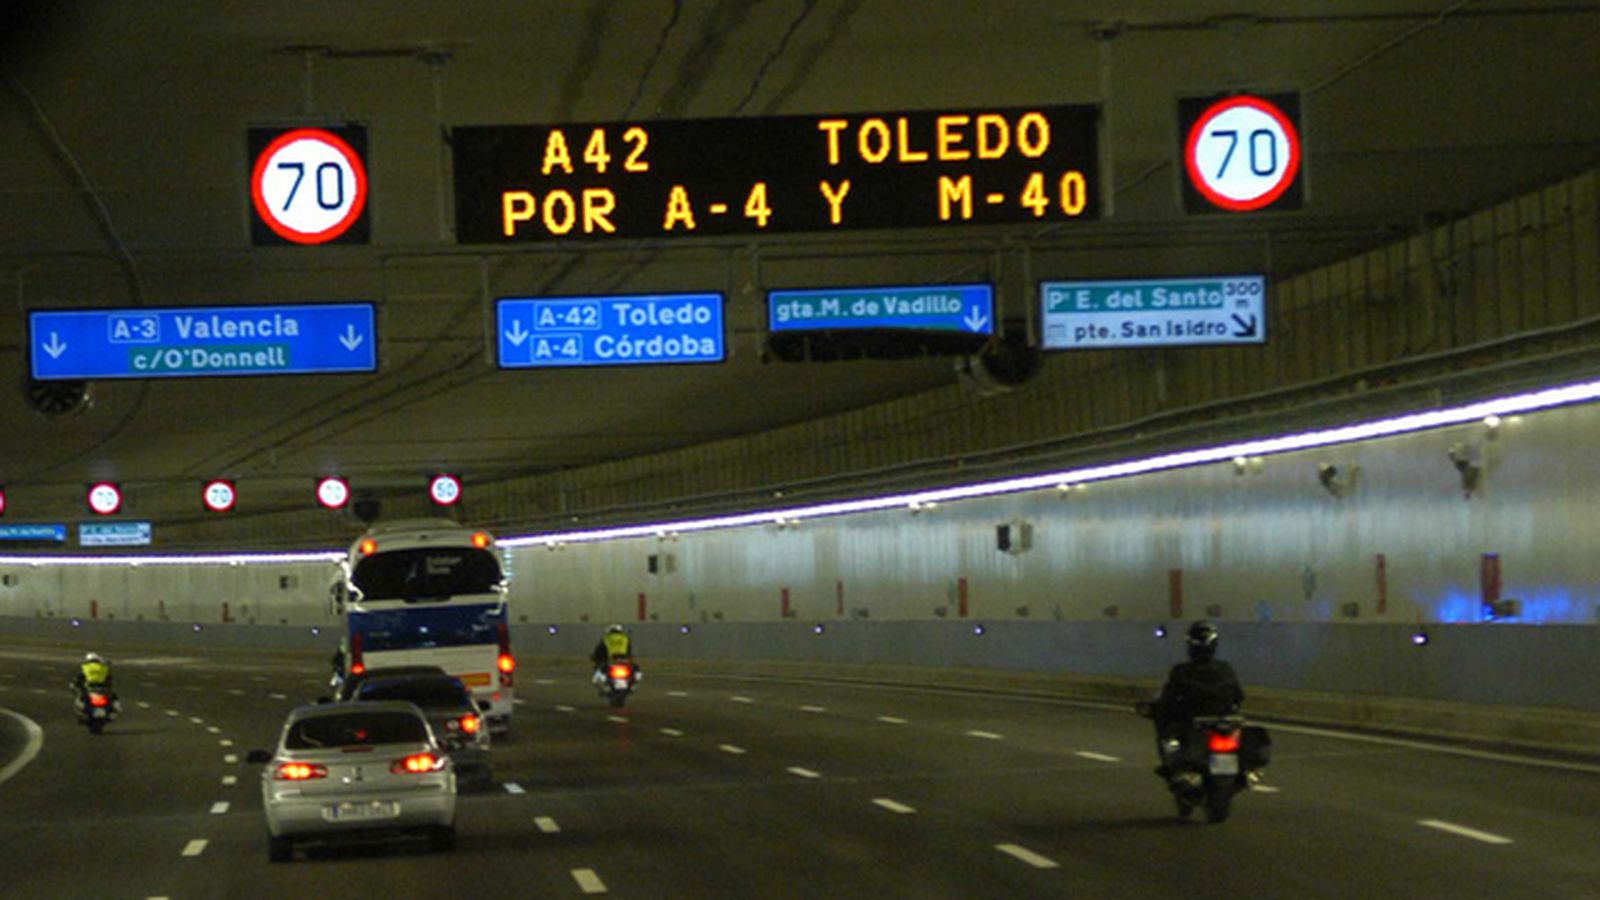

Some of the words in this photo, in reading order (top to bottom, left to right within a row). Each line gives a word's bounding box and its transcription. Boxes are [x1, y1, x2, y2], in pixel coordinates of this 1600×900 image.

[817, 111, 1050, 165] TOLEDO
[541, 126, 648, 175] A42
[1211, 128, 1277, 179] 70
[277, 162, 343, 211] 70
[502, 188, 617, 236] POR
[663, 181, 772, 230] A-4
[819, 180, 850, 224] Y
[938, 170, 1087, 221] M-40
[1106, 290, 1143, 308] del
[1152, 287, 1222, 307] Santo
[1226, 282, 1261, 296] 300
[539, 306, 597, 326] A-42
[612, 303, 711, 326] Toledo
[852, 299, 879, 316] de
[884, 295, 962, 315] Vadillo
[113, 319, 156, 339] A-3
[174, 314, 299, 338] Valencia
[1075, 325, 1116, 341] pte.
[1121, 321, 1161, 338] San
[1166, 320, 1227, 337] Isidro
[535, 339, 578, 357] A-4
[594, 334, 716, 358] Córdoba
[211, 488, 230, 504] 70
[436, 482, 456, 498] 50
